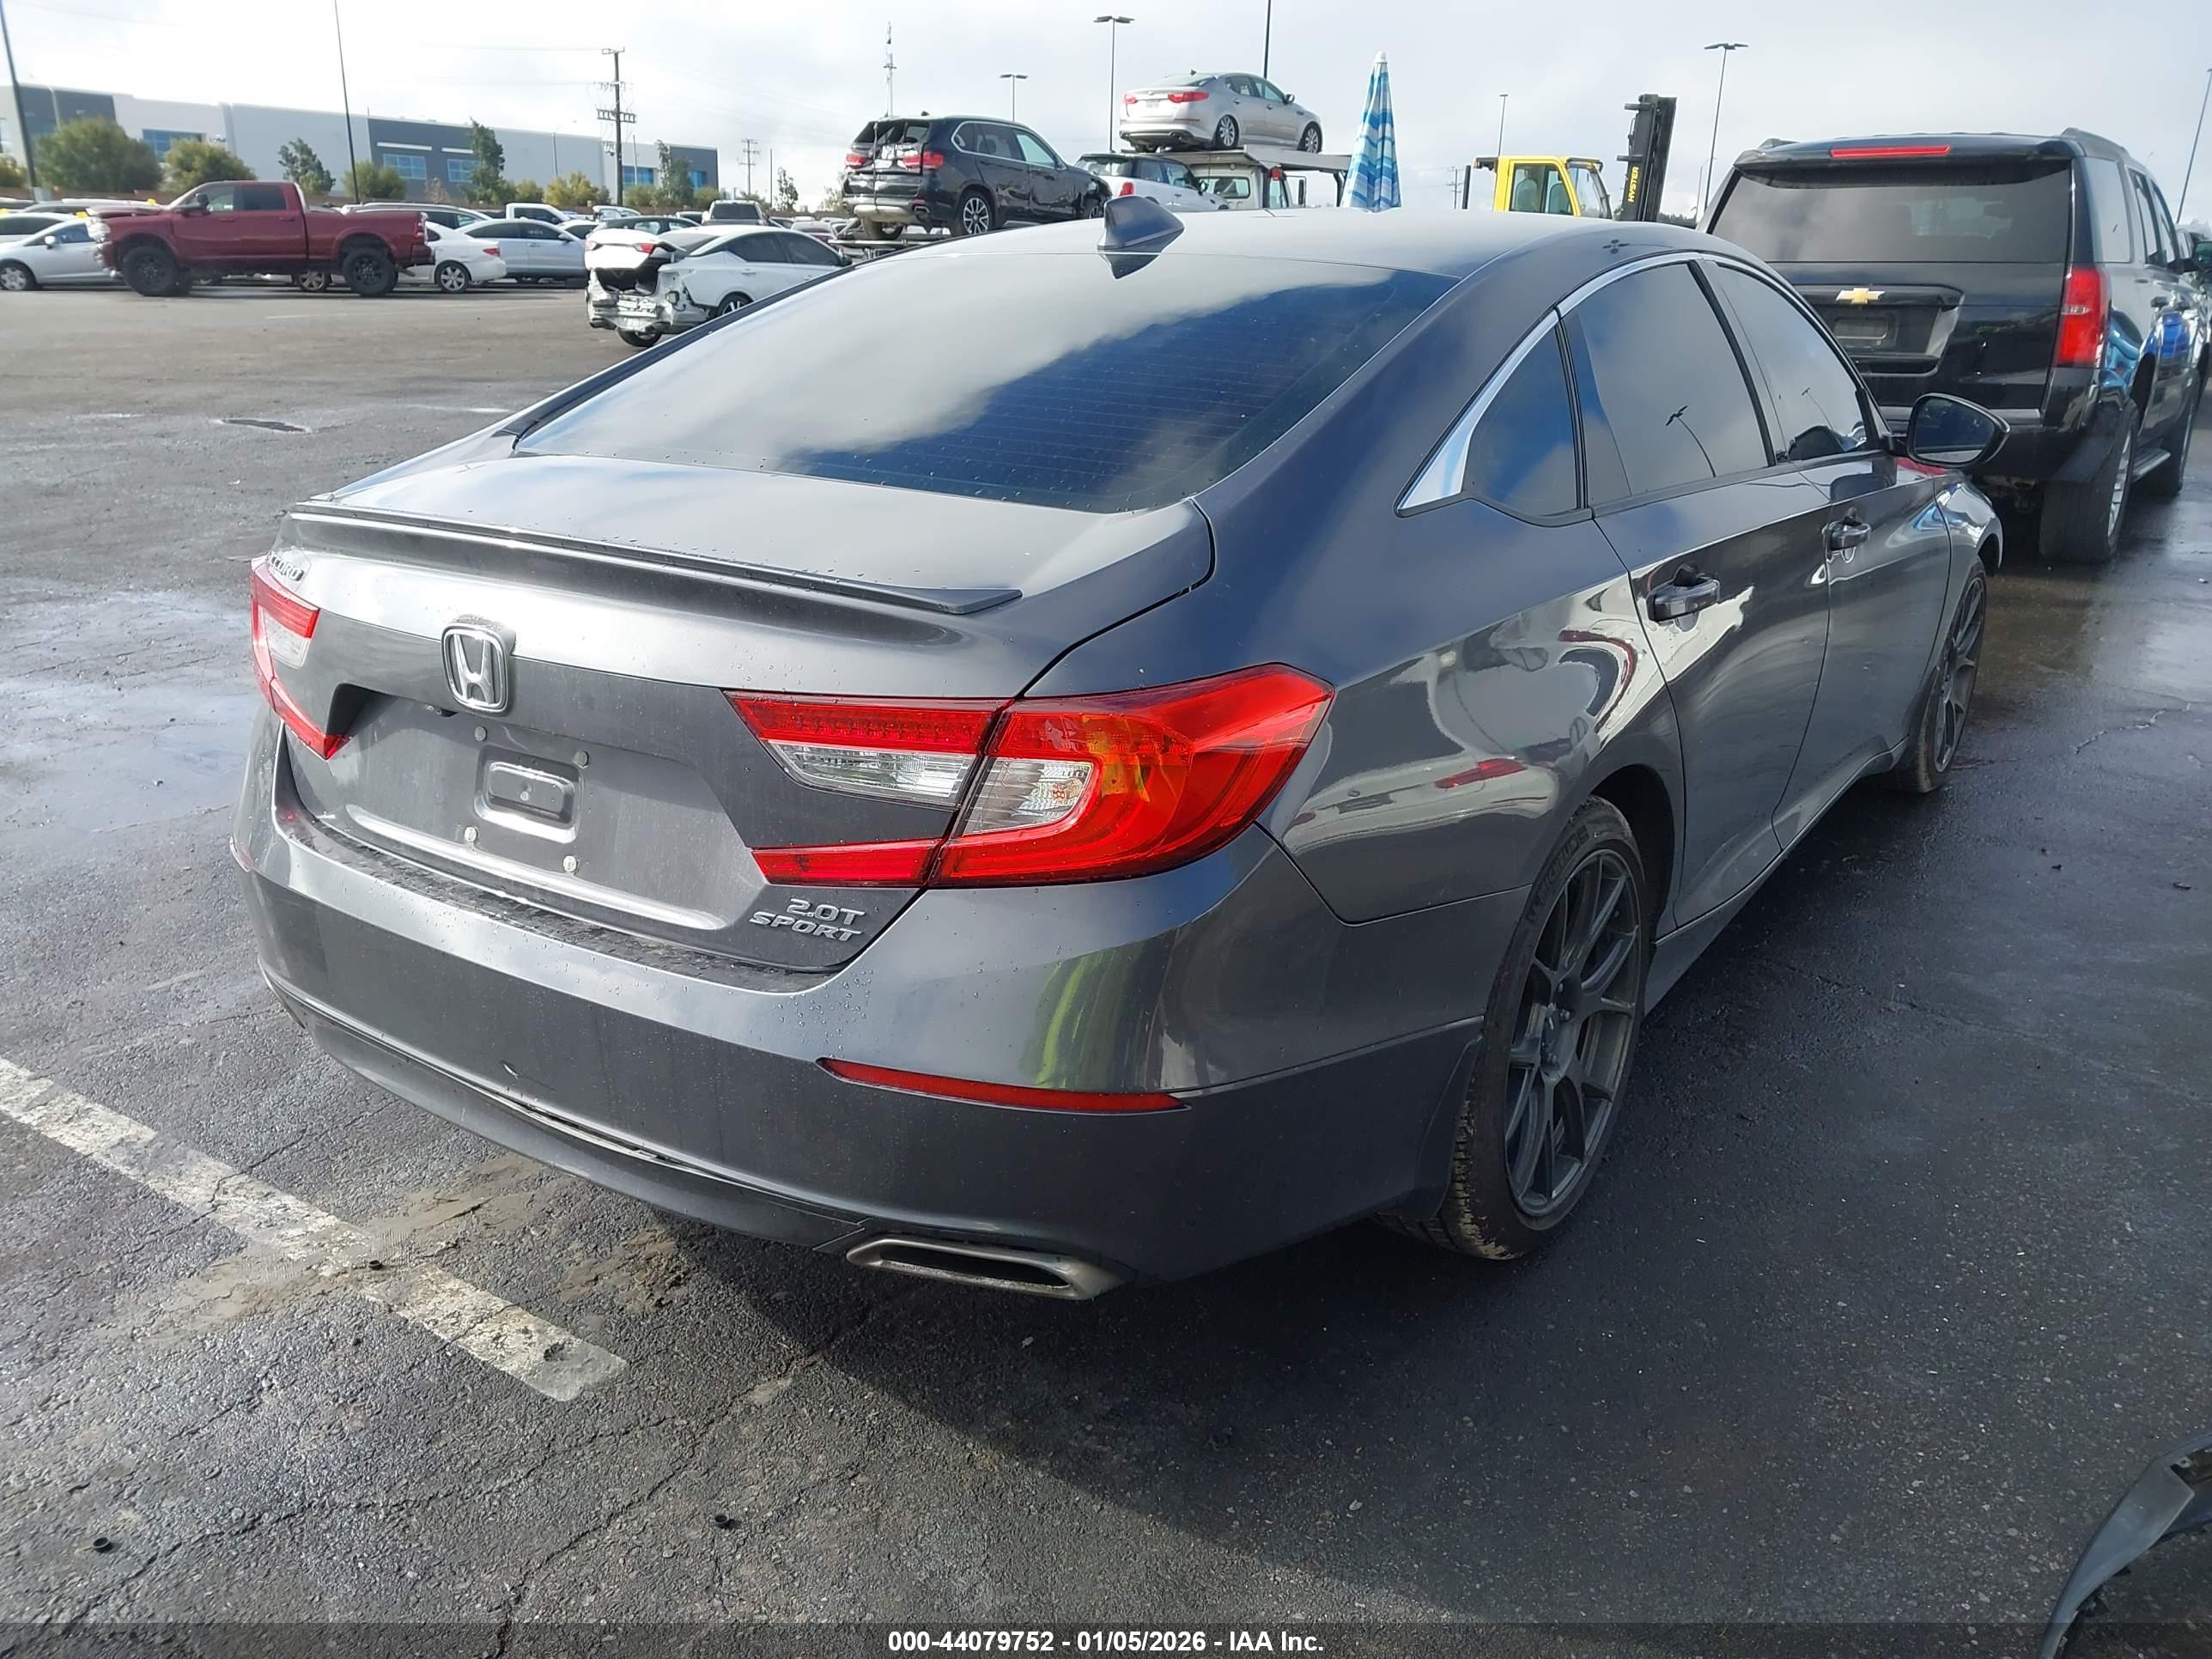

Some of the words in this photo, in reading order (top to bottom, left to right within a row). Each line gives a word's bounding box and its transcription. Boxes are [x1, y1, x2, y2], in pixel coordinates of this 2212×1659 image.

[1627, 165, 1639, 203] HYSTER
[749, 911, 864, 941] SPORT
[786, 897, 866, 925] 2.0T
